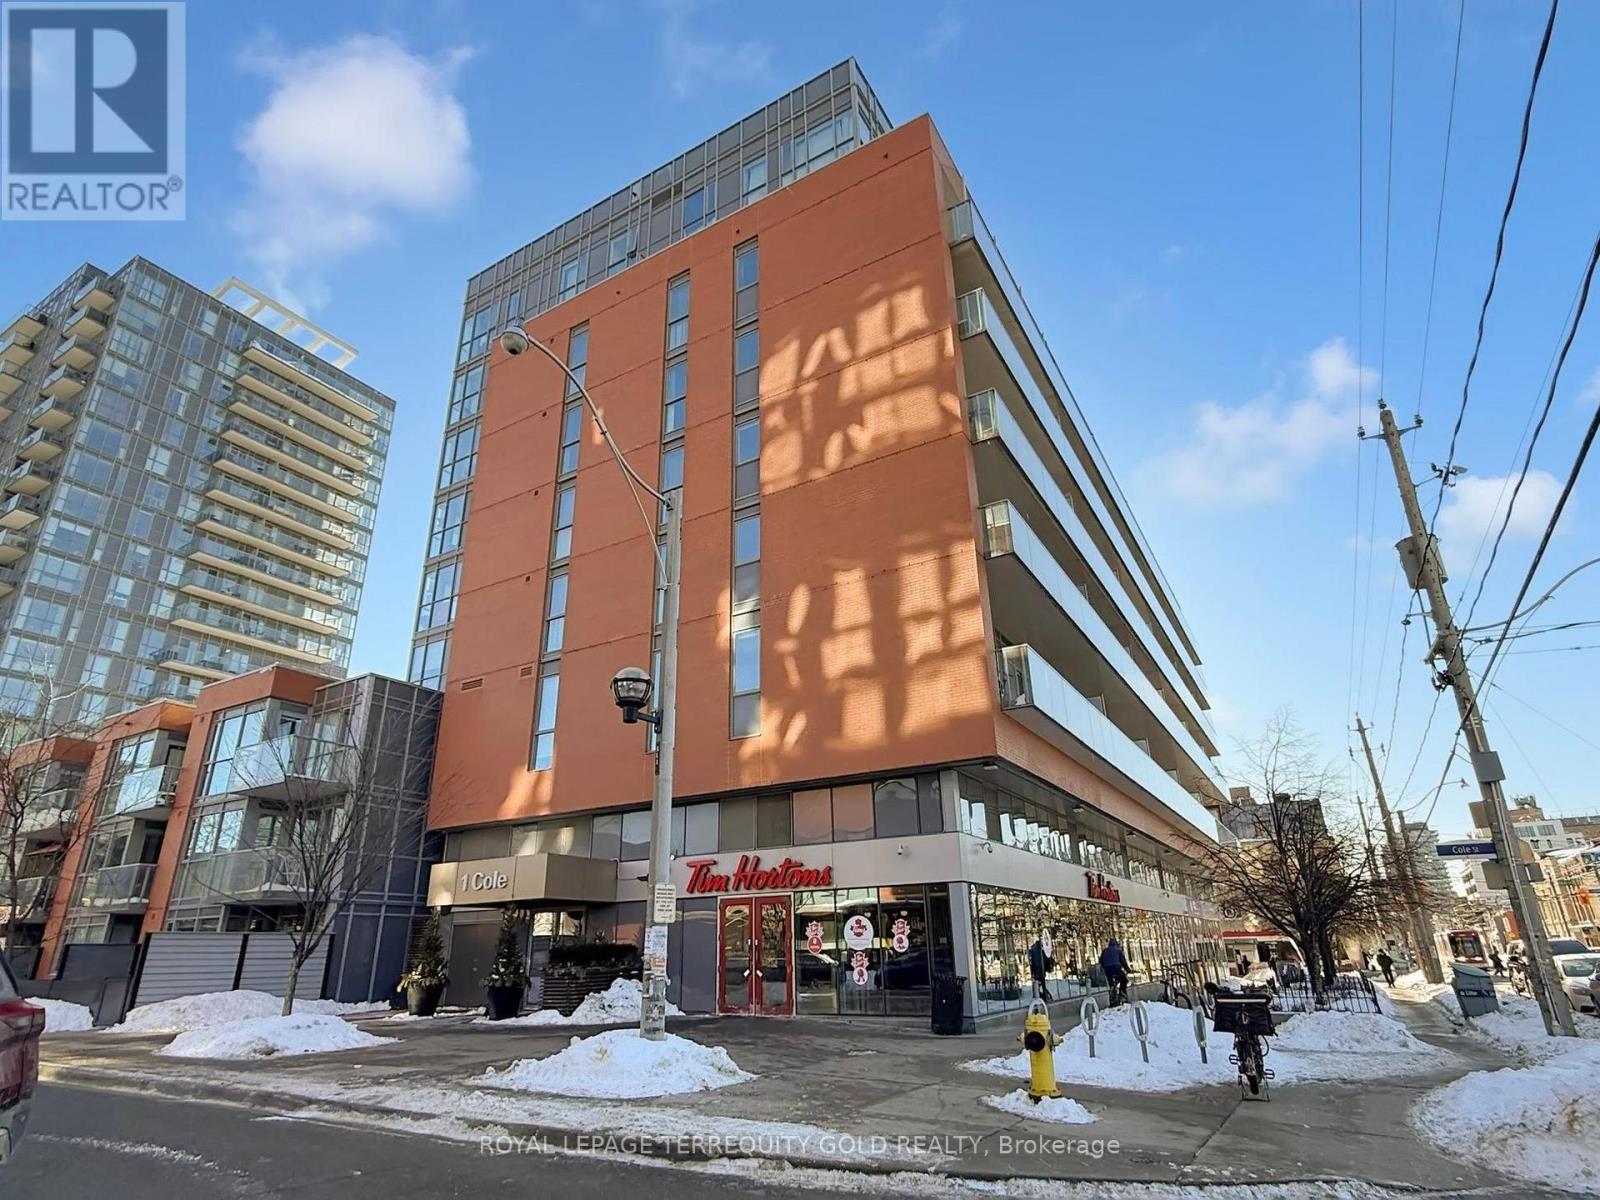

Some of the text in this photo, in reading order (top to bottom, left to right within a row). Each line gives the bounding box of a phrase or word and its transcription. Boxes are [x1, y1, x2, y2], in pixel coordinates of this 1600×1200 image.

[461, 871, 508, 892] 1 Cole
[686, 854, 832, 894] Tim Hortons
